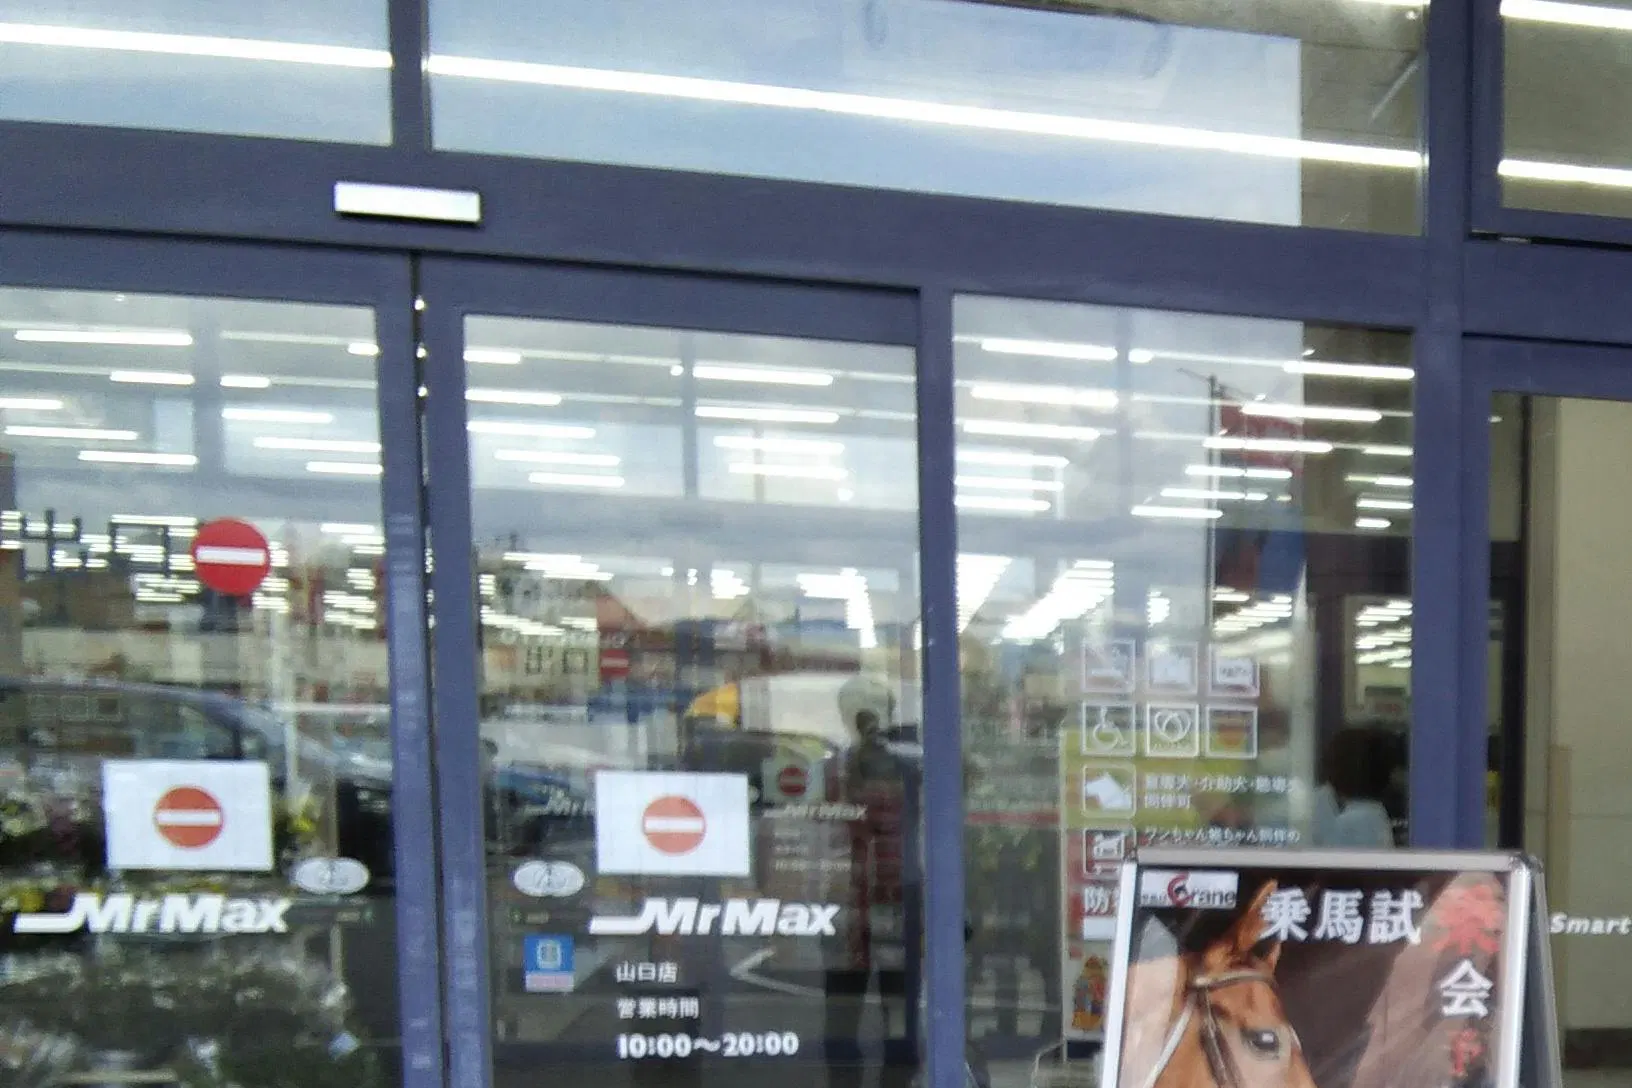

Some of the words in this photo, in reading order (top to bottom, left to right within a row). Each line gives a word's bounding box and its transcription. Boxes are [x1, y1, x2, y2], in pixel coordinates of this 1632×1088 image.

[14, 893, 292, 934] MrMax
[589, 897, 841, 936] MrMax
[1550, 912, 1632, 935] Smart
[615, 961, 679, 985] 山口店
[616, 997, 699, 1019] 営業時間
